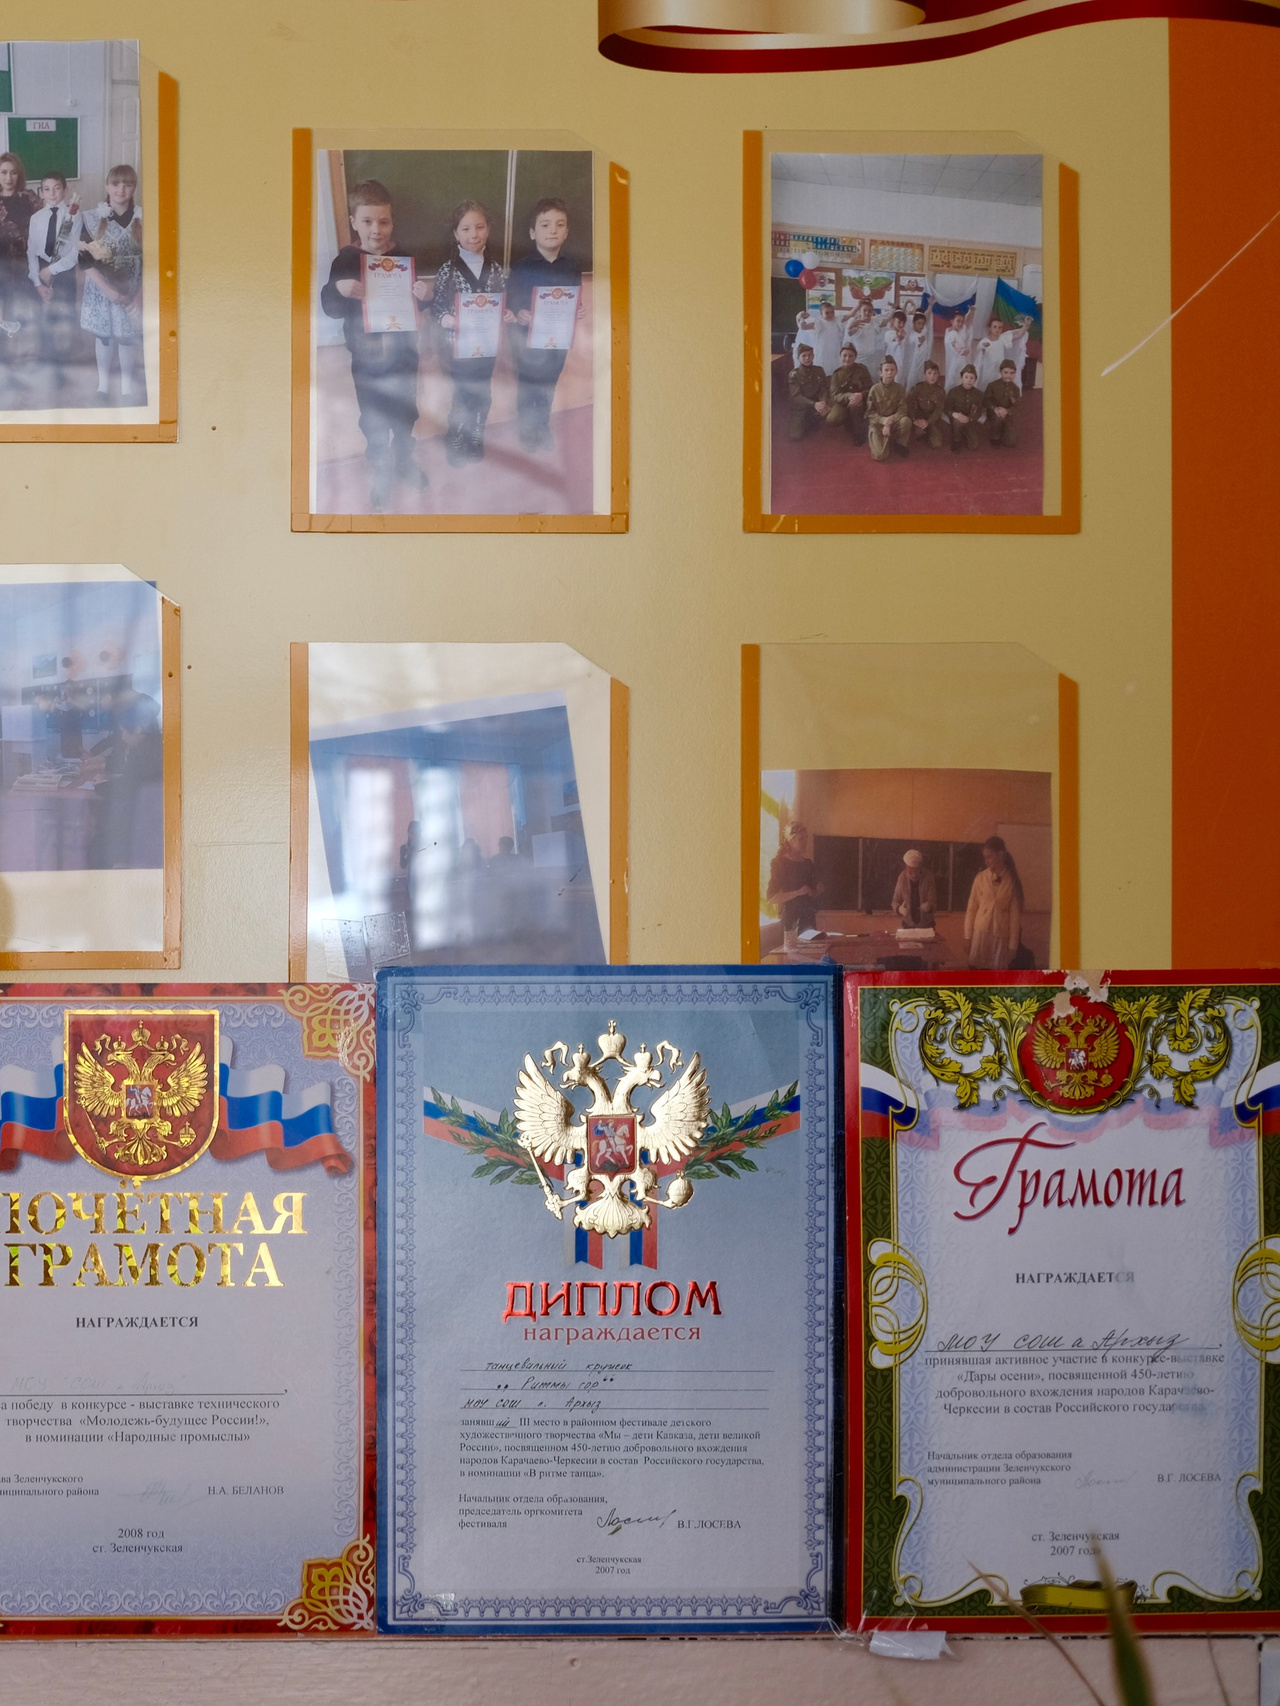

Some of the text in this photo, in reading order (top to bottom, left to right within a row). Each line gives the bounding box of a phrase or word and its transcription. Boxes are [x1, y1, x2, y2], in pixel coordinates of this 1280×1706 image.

[953, 1121, 1187, 1236] Грамота
[4, 1242, 286, 1288] ГРАМОТА
[1015, 1271, 1136, 1286] НАГРАЖДАЕТСЯ
[502, 1281, 722, 1322] ДИПЛОМ
[76, 1316, 199, 1330] НАГРАЖДАЕТСЯ
[524, 1326, 701, 1345] награждается
[925, 1356, 991, 1369] принявшая
[995, 1356, 1049, 1366] активное
[1052, 1355, 1098, 1367] участие
[957, 1370, 996, 1385] «Дары
[1000, 1372, 1044, 1382] осени»,
[1048, 1369, 1127, 1381] посвященной
[935, 1386, 1145, 1402] добровольного вхождения народов
[11, 1398, 280, 1413] победу конкурсе выставке технического
[943, 1401, 1130, 1417] Черкесии состав Российского
[5, 1414, 269, 1429] творчества «Молодежь-будущее России!»,
[533, 1418, 712, 1429] место районном фестивале детского
[35, 1431, 250, 1445] номинации «Народные промыслы»
[460, 1431, 543, 1441] художественного
[545, 1432, 596, 1442] творчества
[598, 1430, 621, 1440] «Мы
[632, 1432, 653, 1440] дети
[722, 1431, 760, 1440] великой
[460, 1442, 747, 1455] России», посвященном 450-летию добровольного вхождения
[459, 1457, 499, 1467] народов
[501, 1455, 598, 1467] Карачаево-Черкесии
[644, 1455, 703, 1465] Российского
[705, 1458, 765, 1468] государства,
[927, 1450, 1072, 1462] Начальник отдела образования
[468, 1470, 605, 1480] номинации ритме танца».
[927, 1463, 1071, 1475] администрации Зеленчукского
[14, 1474, 84, 1484] Зеленчукского
[927, 1472, 1221, 1488] муниципального района В.Г. ЛОСЕВА
[66, 1487, 99, 1498] района
[208, 1486, 229, 1495] Н.А.
[232, 1485, 284, 1495] БЕЛАНОВ
[459, 1493, 608, 1506] Начальник отдела образования,
[458, 1508, 583, 1518] председатель оргкомитета
[458, 1518, 508, 1531] фестиваля
[677, 1519, 742, 1530] В.Г.ЛОСЕВА
[118, 1528, 164, 1539] 2008 год
[110, 1542, 183, 1556] Зеленчукская
[1050, 1545, 1075, 1556] 2007
[595, 1565, 615, 1574] 2007
